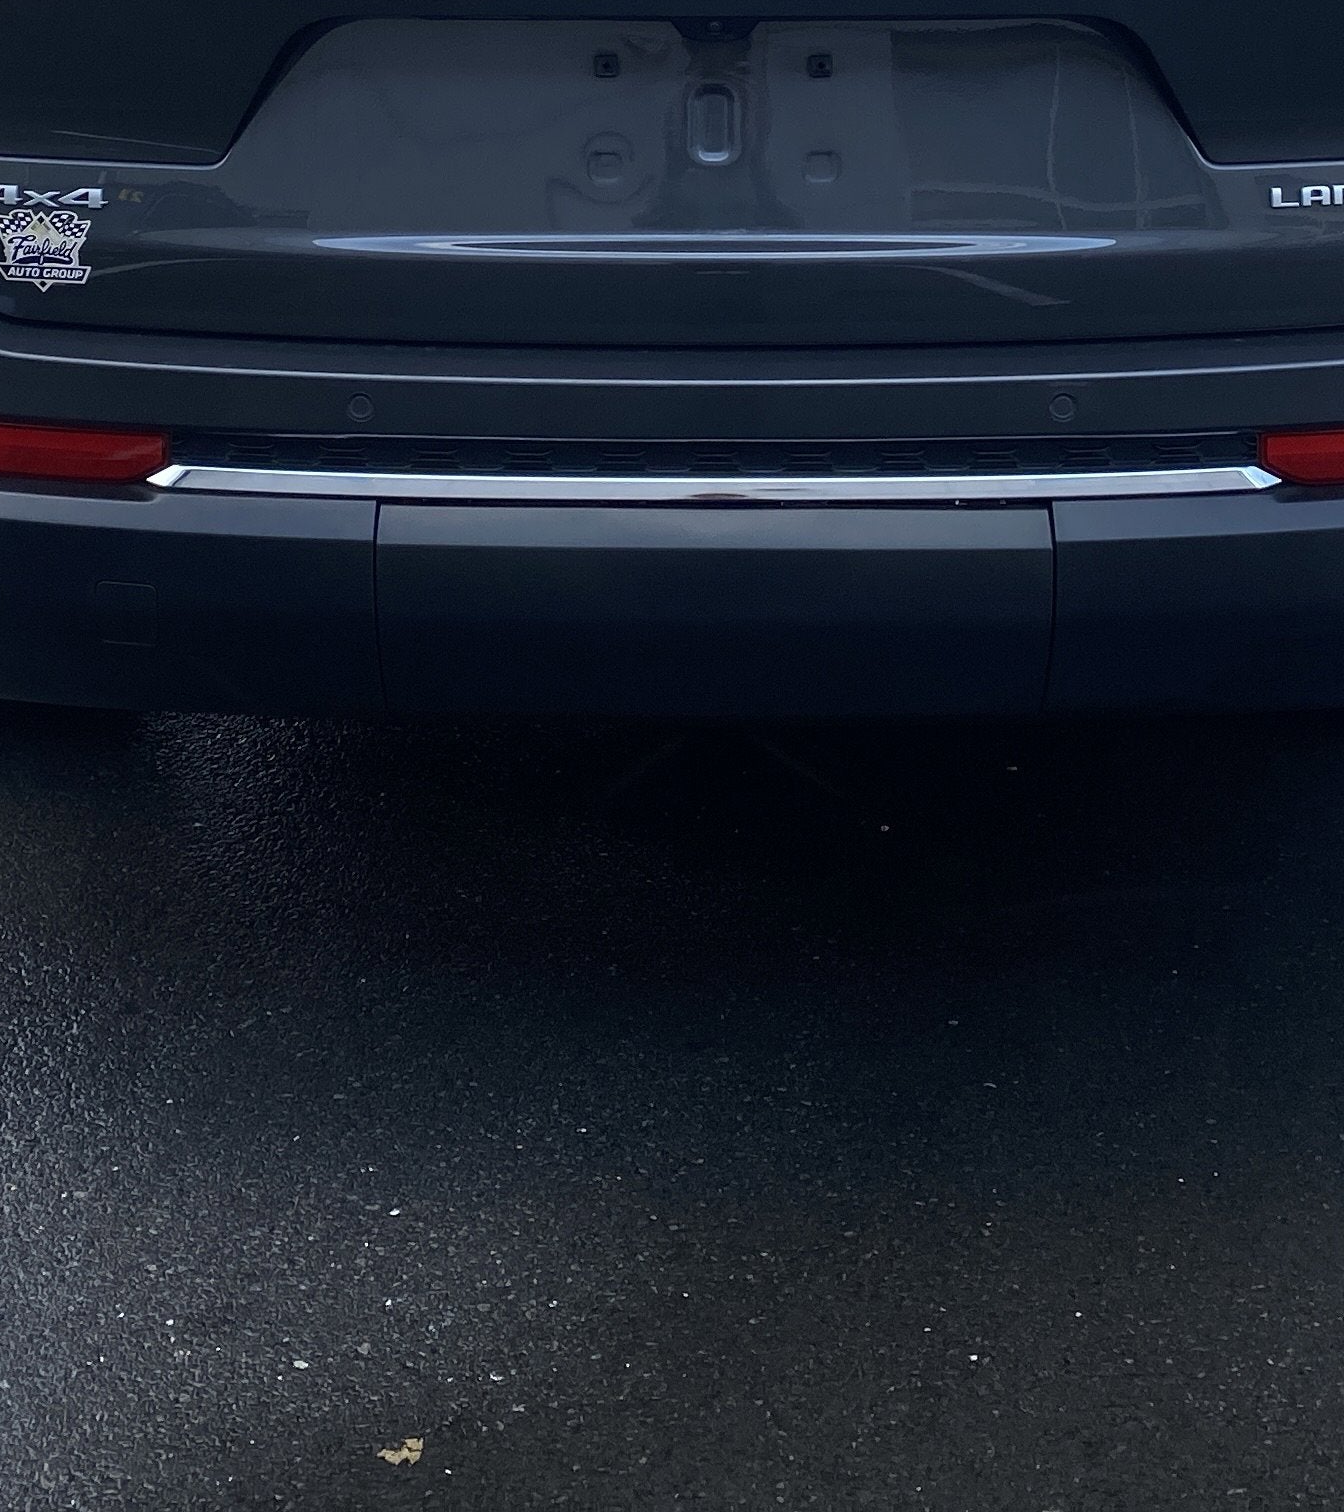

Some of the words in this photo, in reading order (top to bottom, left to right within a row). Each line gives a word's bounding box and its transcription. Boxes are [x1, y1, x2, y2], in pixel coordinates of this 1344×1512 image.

[8, 235, 77, 265] Fairfield
[7, 265, 40, 278] AUTO
[42, 267, 85, 280] GROUP
